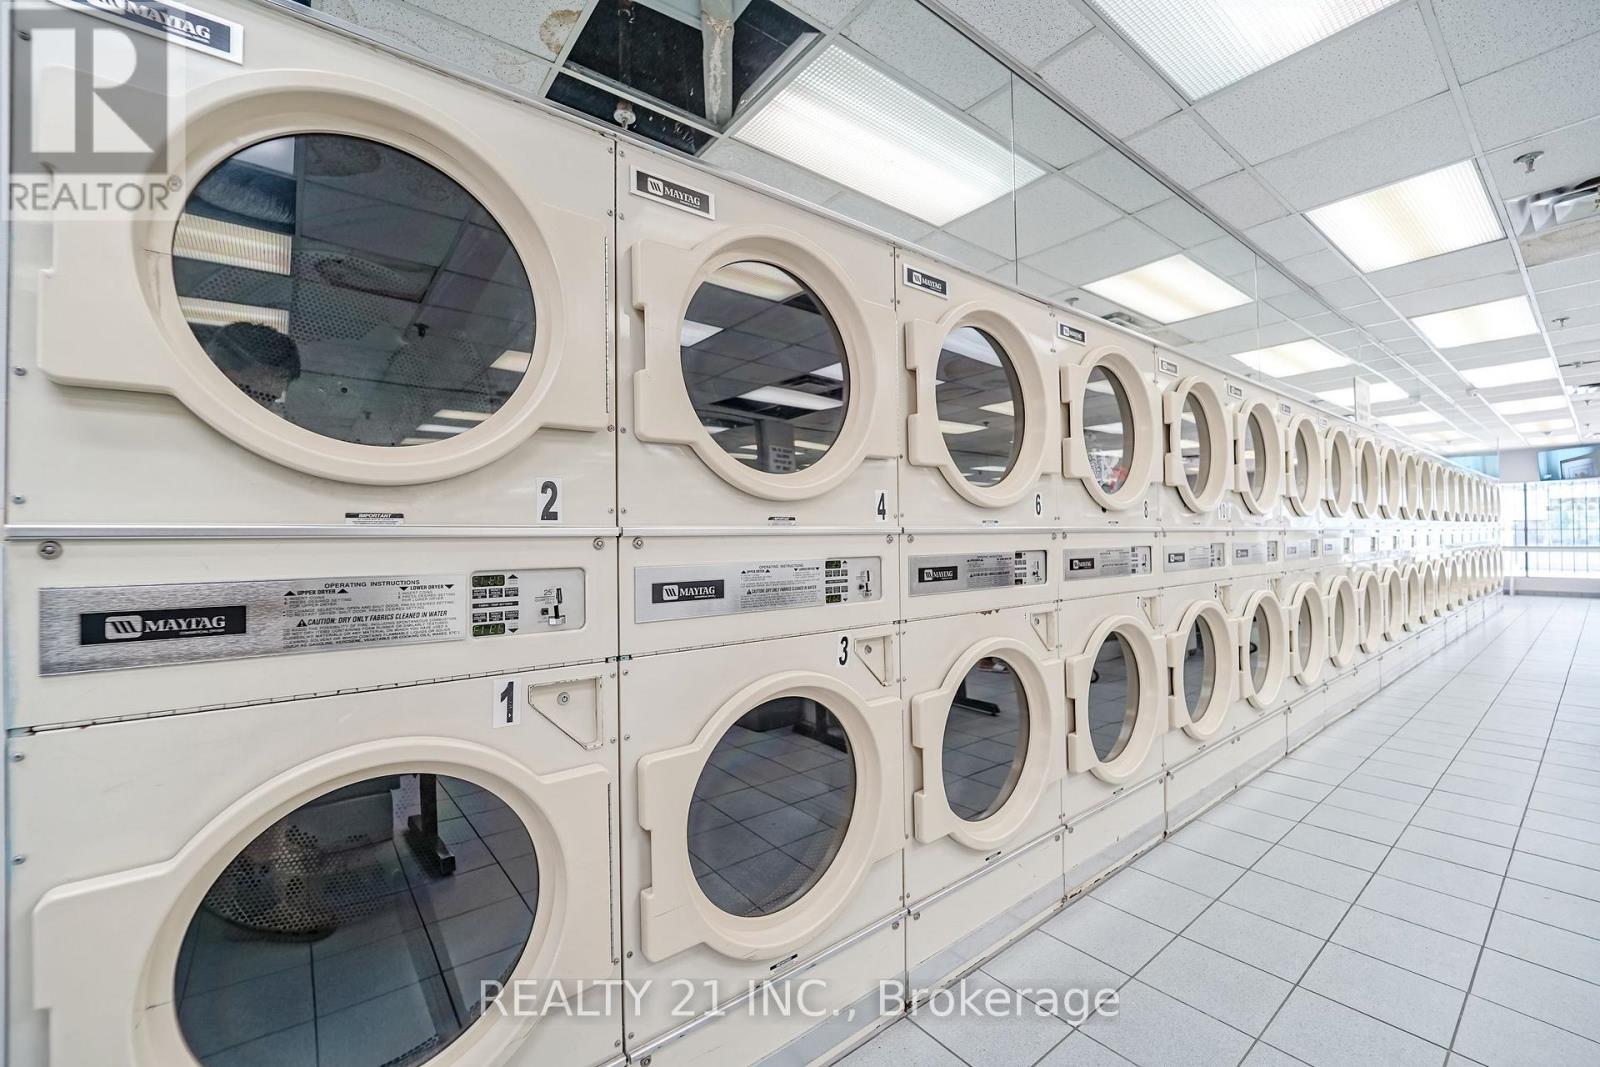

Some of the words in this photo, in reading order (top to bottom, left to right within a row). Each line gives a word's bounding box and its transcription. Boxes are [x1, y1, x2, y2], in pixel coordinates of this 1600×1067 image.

[127, 2, 211, 40] MAYTAG
[664, 186, 701, 206] MAYTAG
[541, 481, 558, 520] 2
[877, 493, 886, 520] 4
[1036, 494, 1041, 516] 6
[324, 581, 367, 589] OPERATING
[680, 586, 716, 597] MAYTAG
[144, 615, 226, 633] MAYTAG
[338, 616, 352, 624] DRY
[352, 615, 370, 623] ONLY
[370, 613, 394, 621] FABRICS
[395, 612, 420, 620] CLEANED
[839, 636, 848, 665] 3
[500, 681, 514, 723] 1
